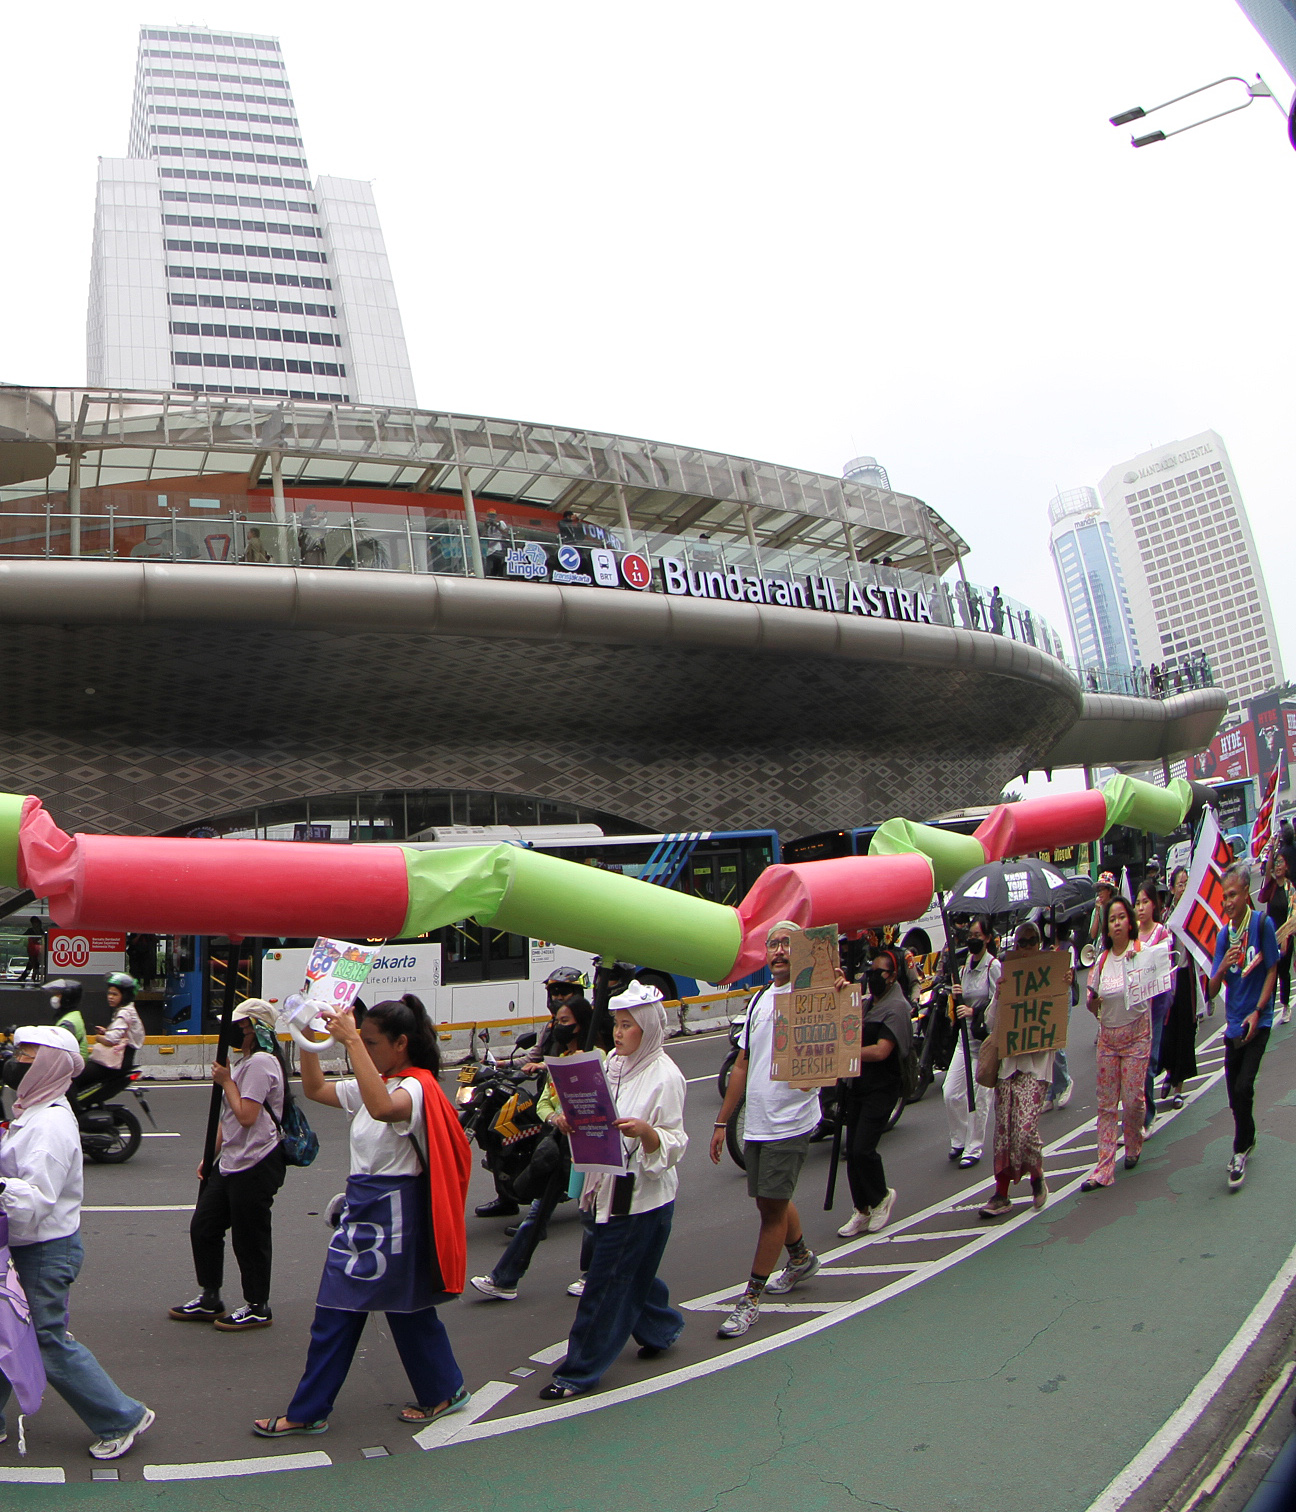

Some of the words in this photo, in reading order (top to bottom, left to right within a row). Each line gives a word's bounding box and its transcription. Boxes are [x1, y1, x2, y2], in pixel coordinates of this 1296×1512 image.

[1138, 457, 1177, 479] MANDARIN
[1178, 444, 1213, 464] ORIENTAL
[507, 549, 526, 562] Jak
[632, 560, 639, 570] 1
[508, 561, 546, 577] Lingko
[554, 571, 590, 583] transjakarta
[600, 572, 612, 581] BRT
[631, 572, 643, 582] 11
[660, 557, 808, 607] Bundaran
[808, 575, 840, 611] HI
[846, 581, 933, 624] ASTRA
[1220, 730, 1242, 753] HYDE
[52, 935, 90, 968] 80
[373, 955, 417, 970] akarta
[366, 976, 381, 984] Life
[390, 976, 417, 984] Jakarta
[1012, 966, 1051, 996] TAX
[334, 981, 356, 1002] OR
[795, 992, 836, 1014] KITA
[1011, 999, 1053, 1029] THE
[794, 1022, 837, 1044] UDARA
[1007, 1023, 1056, 1055] RICH
[794, 1043, 835, 1057] YANG
[792, 1057, 833, 1077] BERSIH
